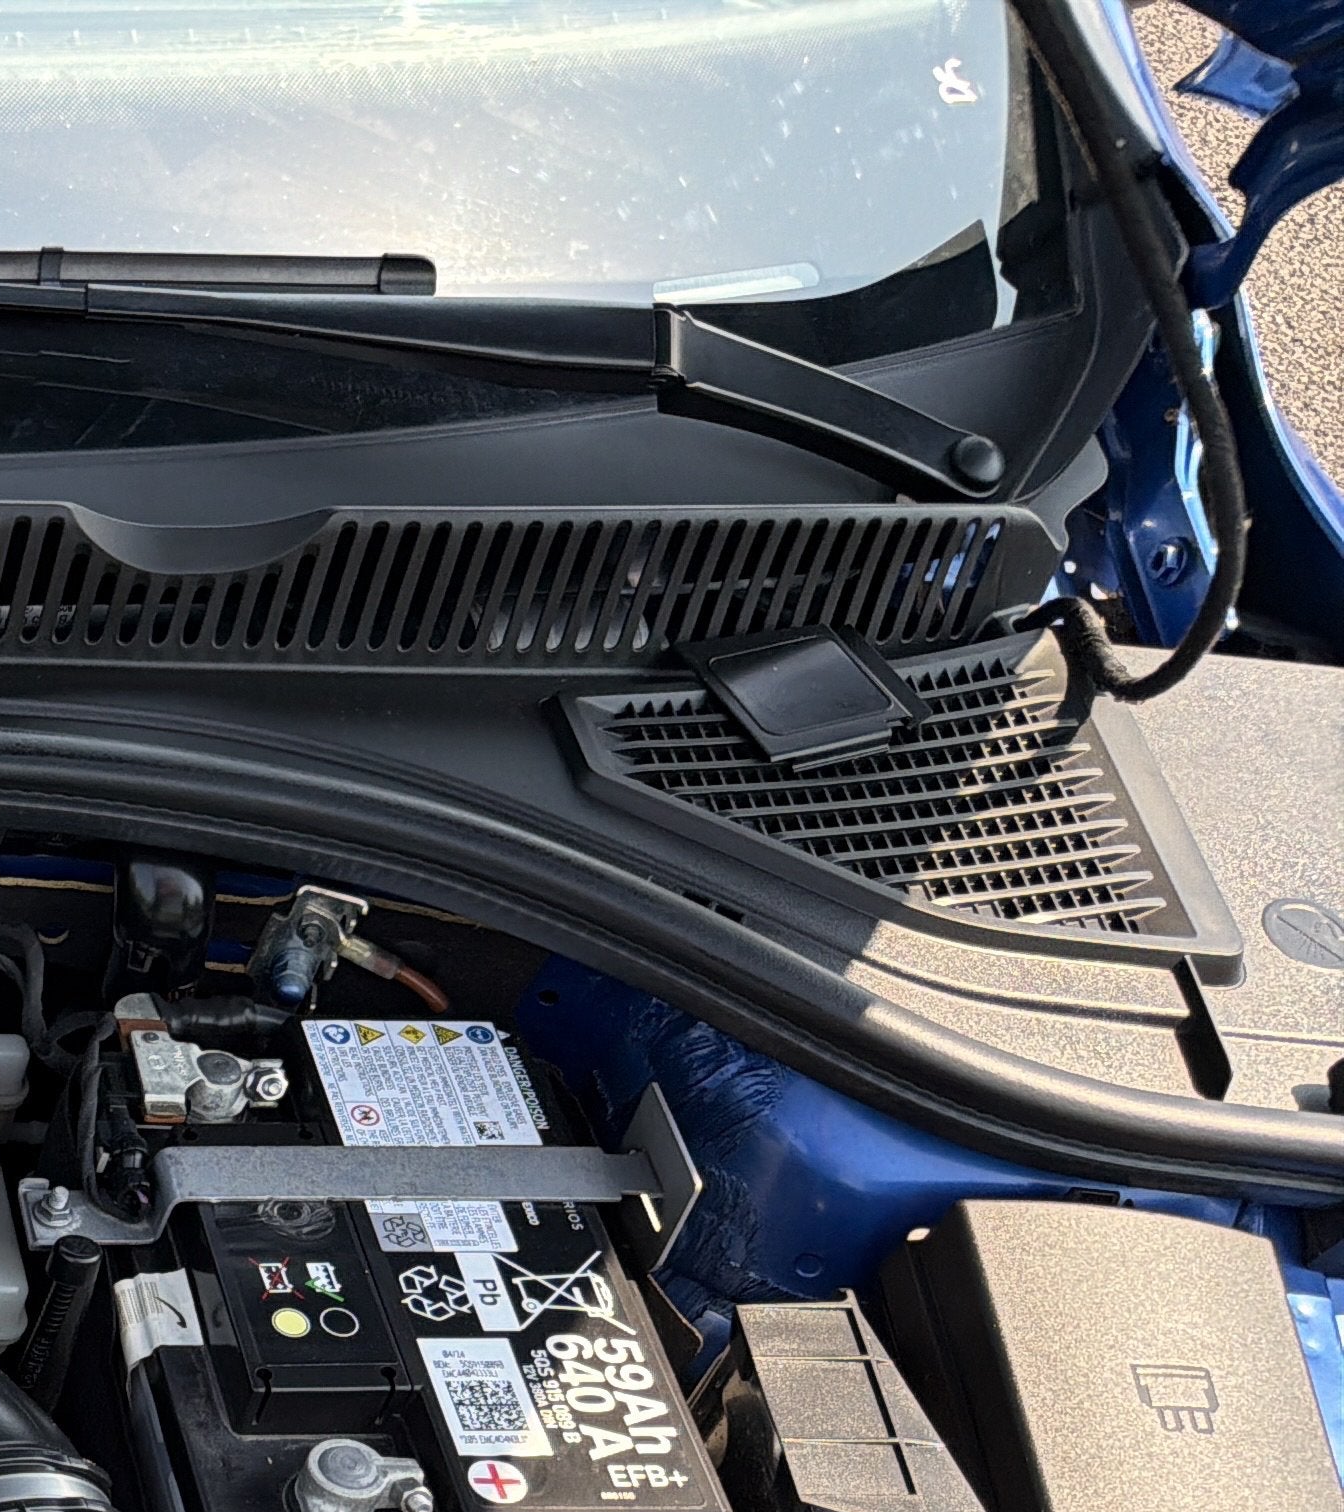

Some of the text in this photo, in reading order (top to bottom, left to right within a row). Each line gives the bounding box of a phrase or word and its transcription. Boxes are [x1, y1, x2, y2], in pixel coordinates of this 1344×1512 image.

[503, 1046, 550, 1129] DANGER/POISON
[522, 1201, 540, 1226] EXICO
[563, 1201, 584, 1231] RIOS
[473, 1278, 502, 1307] Pb
[522, 1364, 539, 1381] 12V
[539, 1409, 559, 1429] DIN
[530, 1349, 583, 1444] 5QS 915 089 B
[545, 1334, 634, 1461] 640 A
[594, 1337, 678, 1455] 59Ah
[606, 1464, 689, 1488] EFB+
